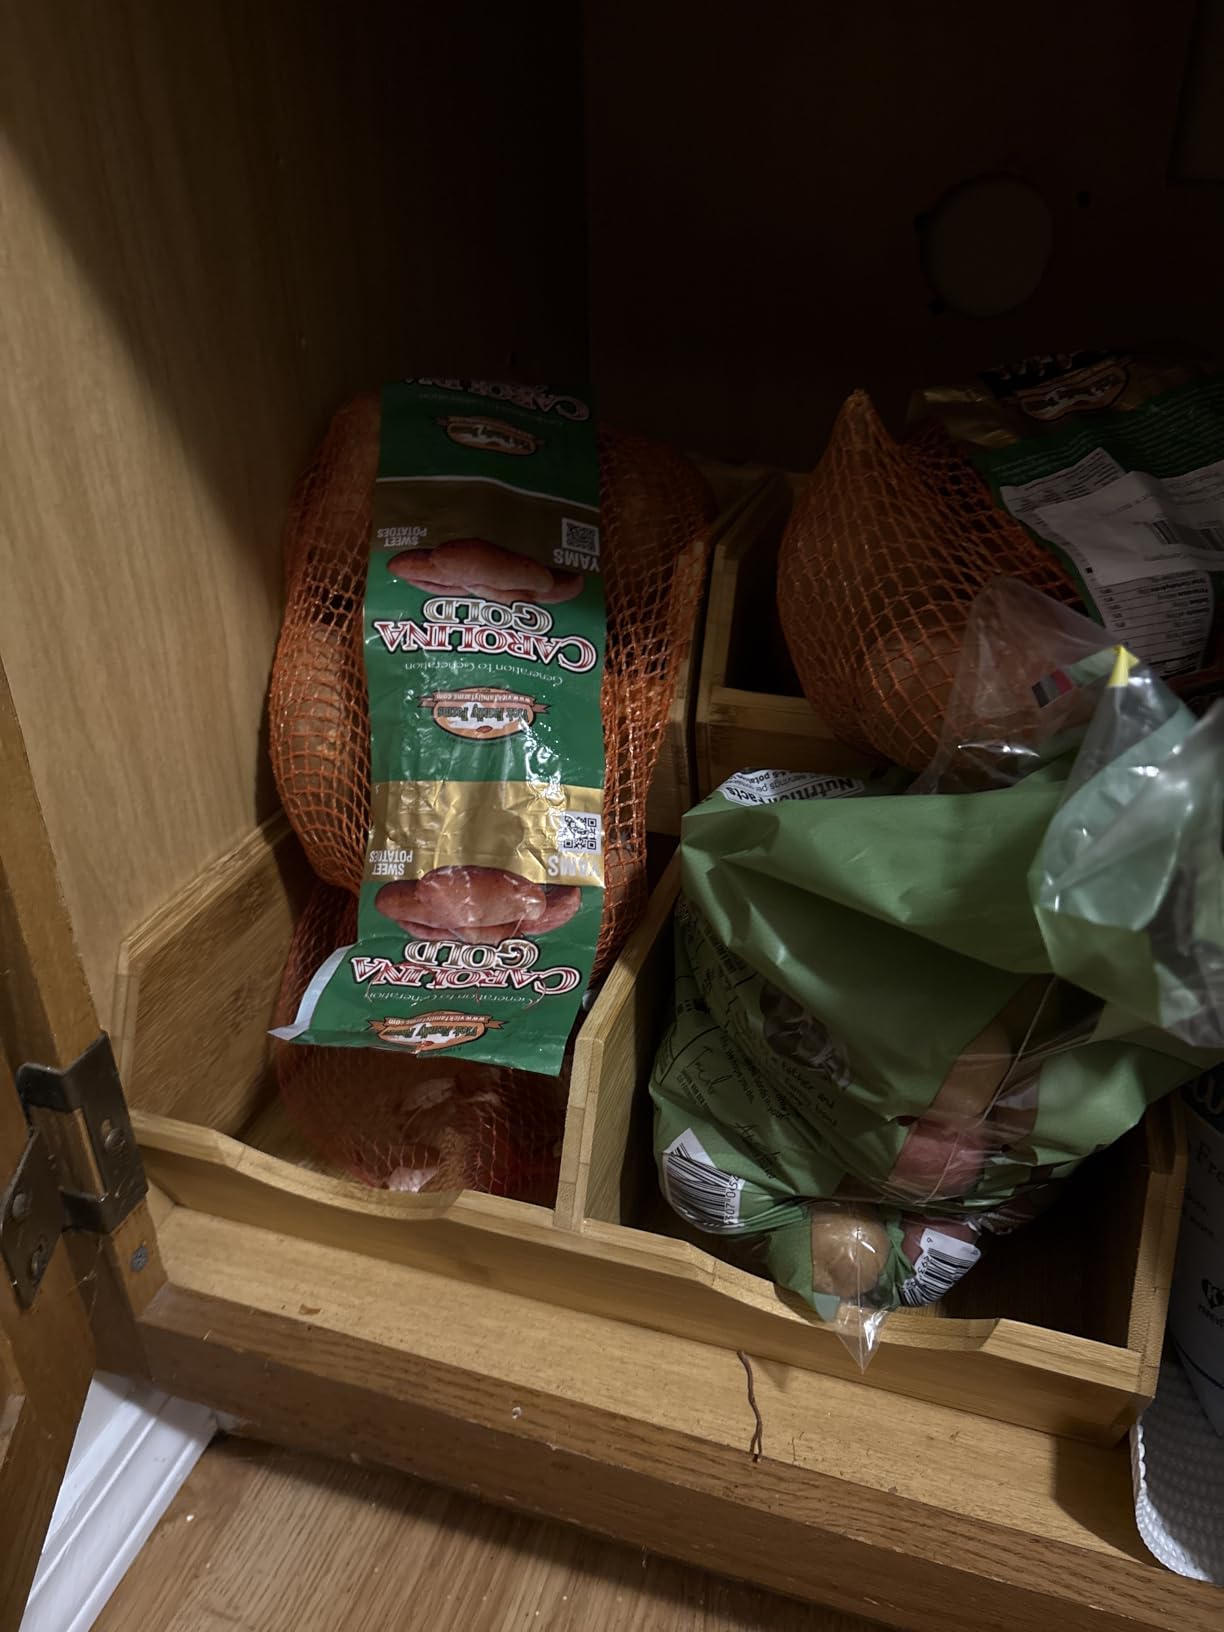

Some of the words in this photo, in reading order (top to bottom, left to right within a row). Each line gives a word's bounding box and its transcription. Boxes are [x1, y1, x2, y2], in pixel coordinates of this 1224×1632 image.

[376, 526, 428, 539] POTATOES
[384, 535, 418, 548] SWEET
[552, 548, 601, 574] YAMS
[422, 597, 553, 636] GOLD
[372, 619, 598, 675] CAROLINA
[405, 661, 475, 673] Generation
[478, 663, 494, 674] to
[495, 664, 563, 687] Generation
[369, 850, 413, 863] POTATOES
[372, 863, 405, 876] SWEET
[404, 938, 540, 971] GOLD
[350, 955, 582, 996] CAROLINA
